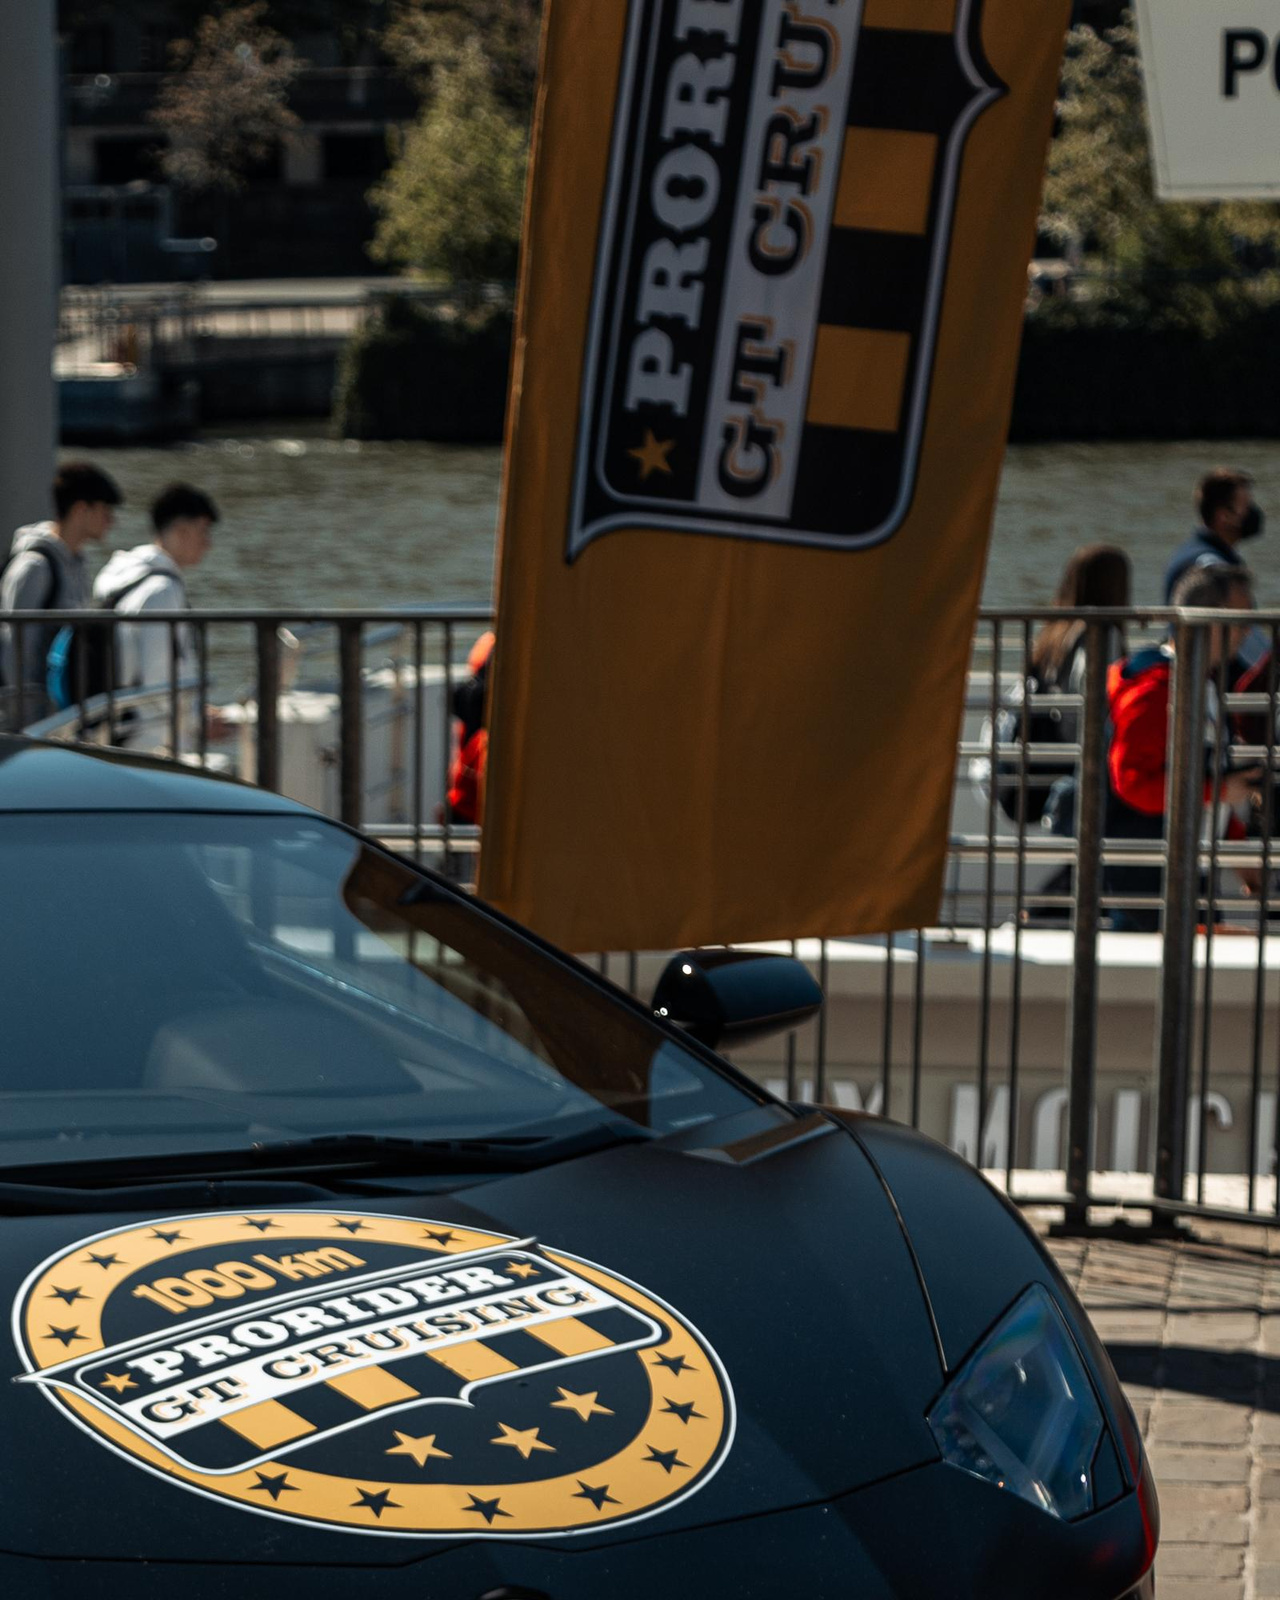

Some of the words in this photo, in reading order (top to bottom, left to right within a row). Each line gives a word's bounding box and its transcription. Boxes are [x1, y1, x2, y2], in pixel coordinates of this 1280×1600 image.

[748, 0, 844, 277] CRU
[717, 313, 797, 500] GT
[125, 1264, 516, 1385] PRORIDER
[131, 1259, 277, 1314] 1000
[252, 1245, 367, 1282] km
[140, 1372, 248, 1424] GT
[261, 1283, 596, 1381] CRUISING
